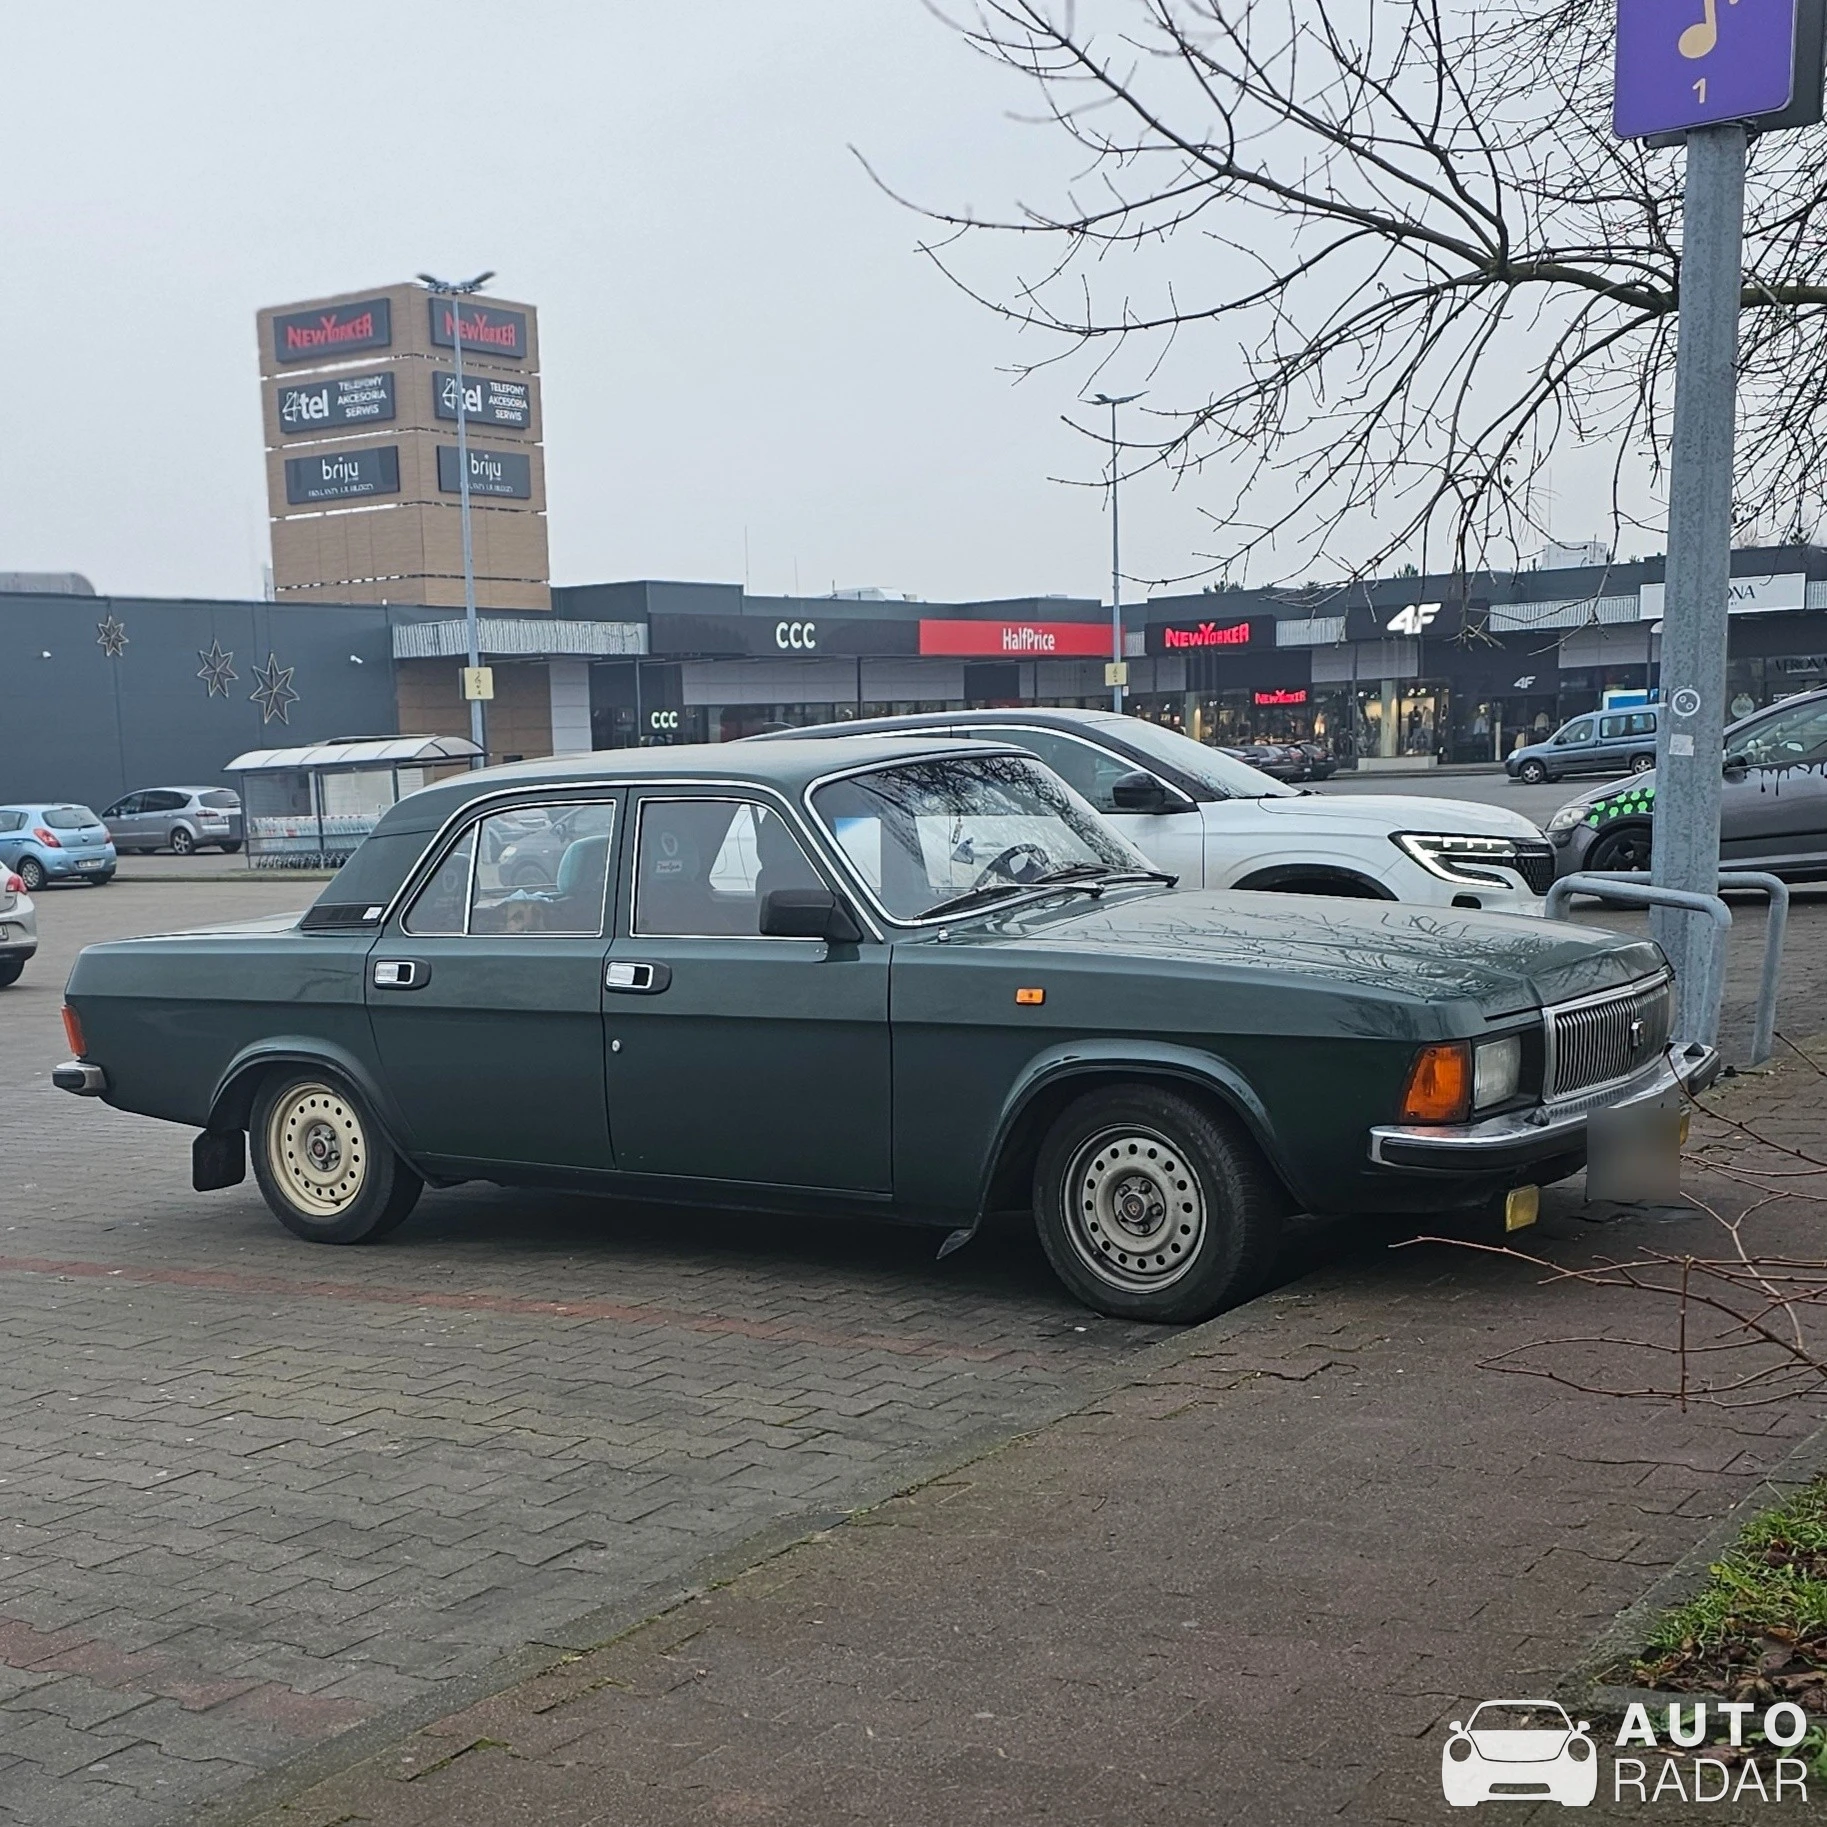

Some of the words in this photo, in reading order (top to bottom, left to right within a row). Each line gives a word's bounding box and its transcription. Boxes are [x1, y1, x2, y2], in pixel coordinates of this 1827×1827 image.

[1692, 78, 1706, 104] 1
[338, 376, 383, 391] TELEFONY
[490, 382, 525, 395] TELEFONY
[337, 390, 387, 405] AKCESORIA
[488, 396, 528, 409] AKCESORIA
[345, 404, 379, 418] SERWIS
[495, 409, 522, 421] SERWIS
[322, 456, 359, 484] briju
[471, 453, 502, 481] briju
[1387, 602, 1442, 635] 4F
[776, 621, 816, 649] CCC
[1003, 626, 1055, 651] HalfPrice
[1513, 675, 1536, 689] 4F
[651, 711, 678, 728] CCC
